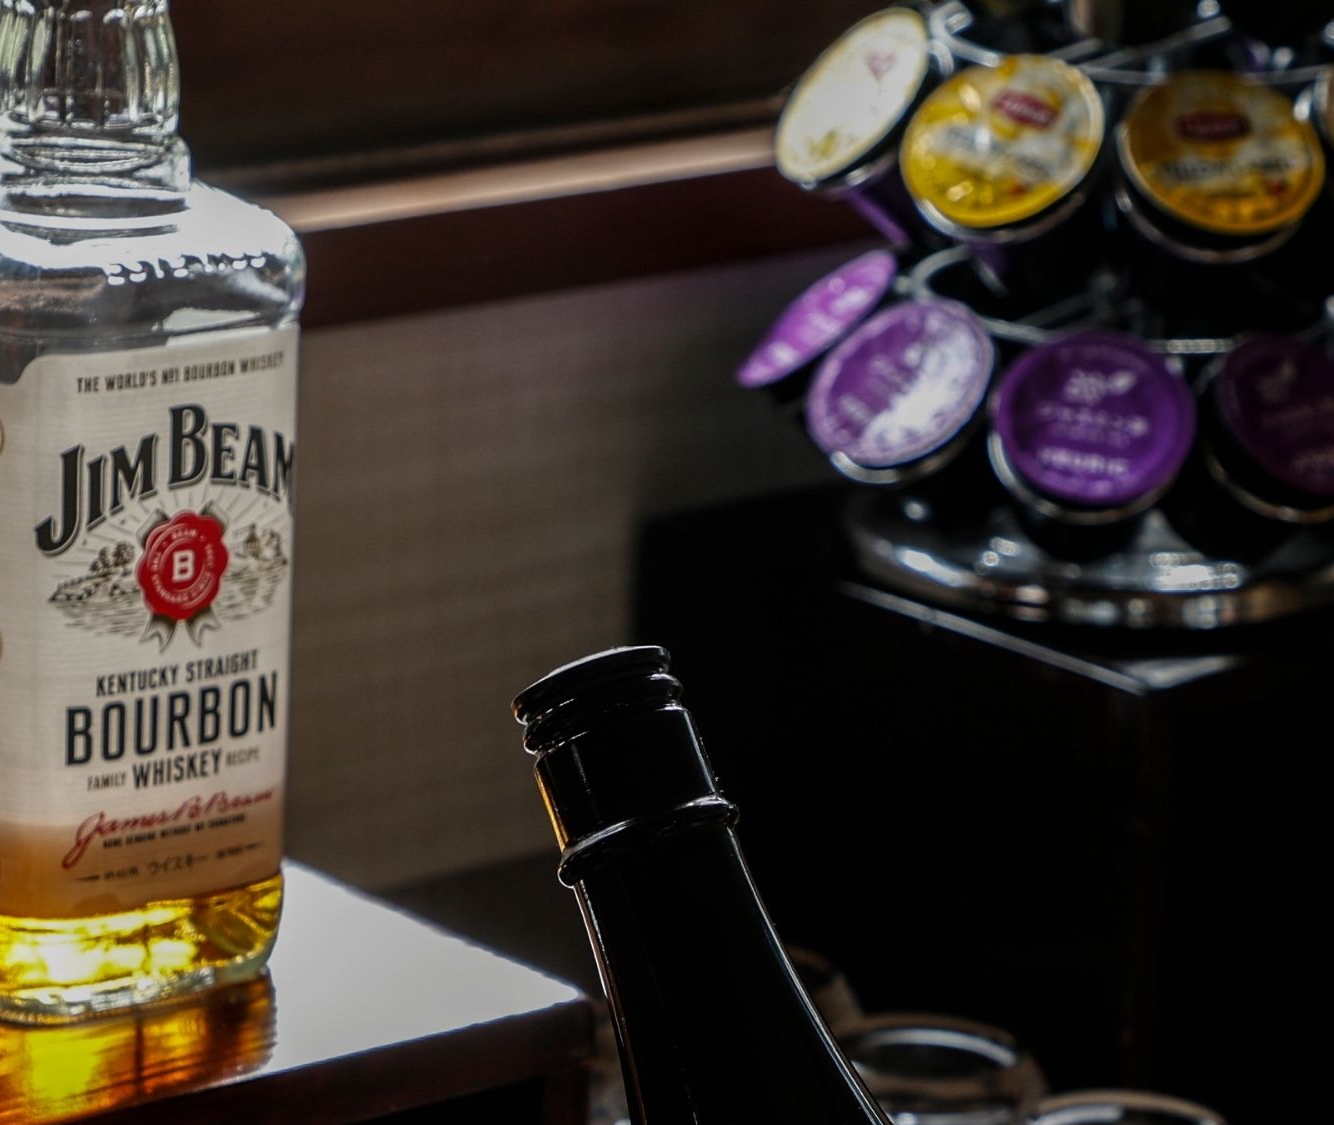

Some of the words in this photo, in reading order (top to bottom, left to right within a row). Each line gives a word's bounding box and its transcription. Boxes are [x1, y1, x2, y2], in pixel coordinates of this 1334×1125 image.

[77, 376, 100, 393] THE
[105, 370, 157, 391] WORLD'S
[183, 360, 235, 382] BOURBON
[239, 350, 285, 374] WHISKEY
[34, 432, 156, 555] JIM
[167, 404, 297, 514] BEAM
[172, 550, 195, 583] B
[97, 663, 178, 697] KENTUCKY
[186, 649, 259, 682] STRAIGHT
[65, 670, 277, 767] BOURBON
[87, 772, 126, 791] FAMILY
[132, 749, 222, 789] WHISKEY
[226, 747, 259, 765] RECIPE
